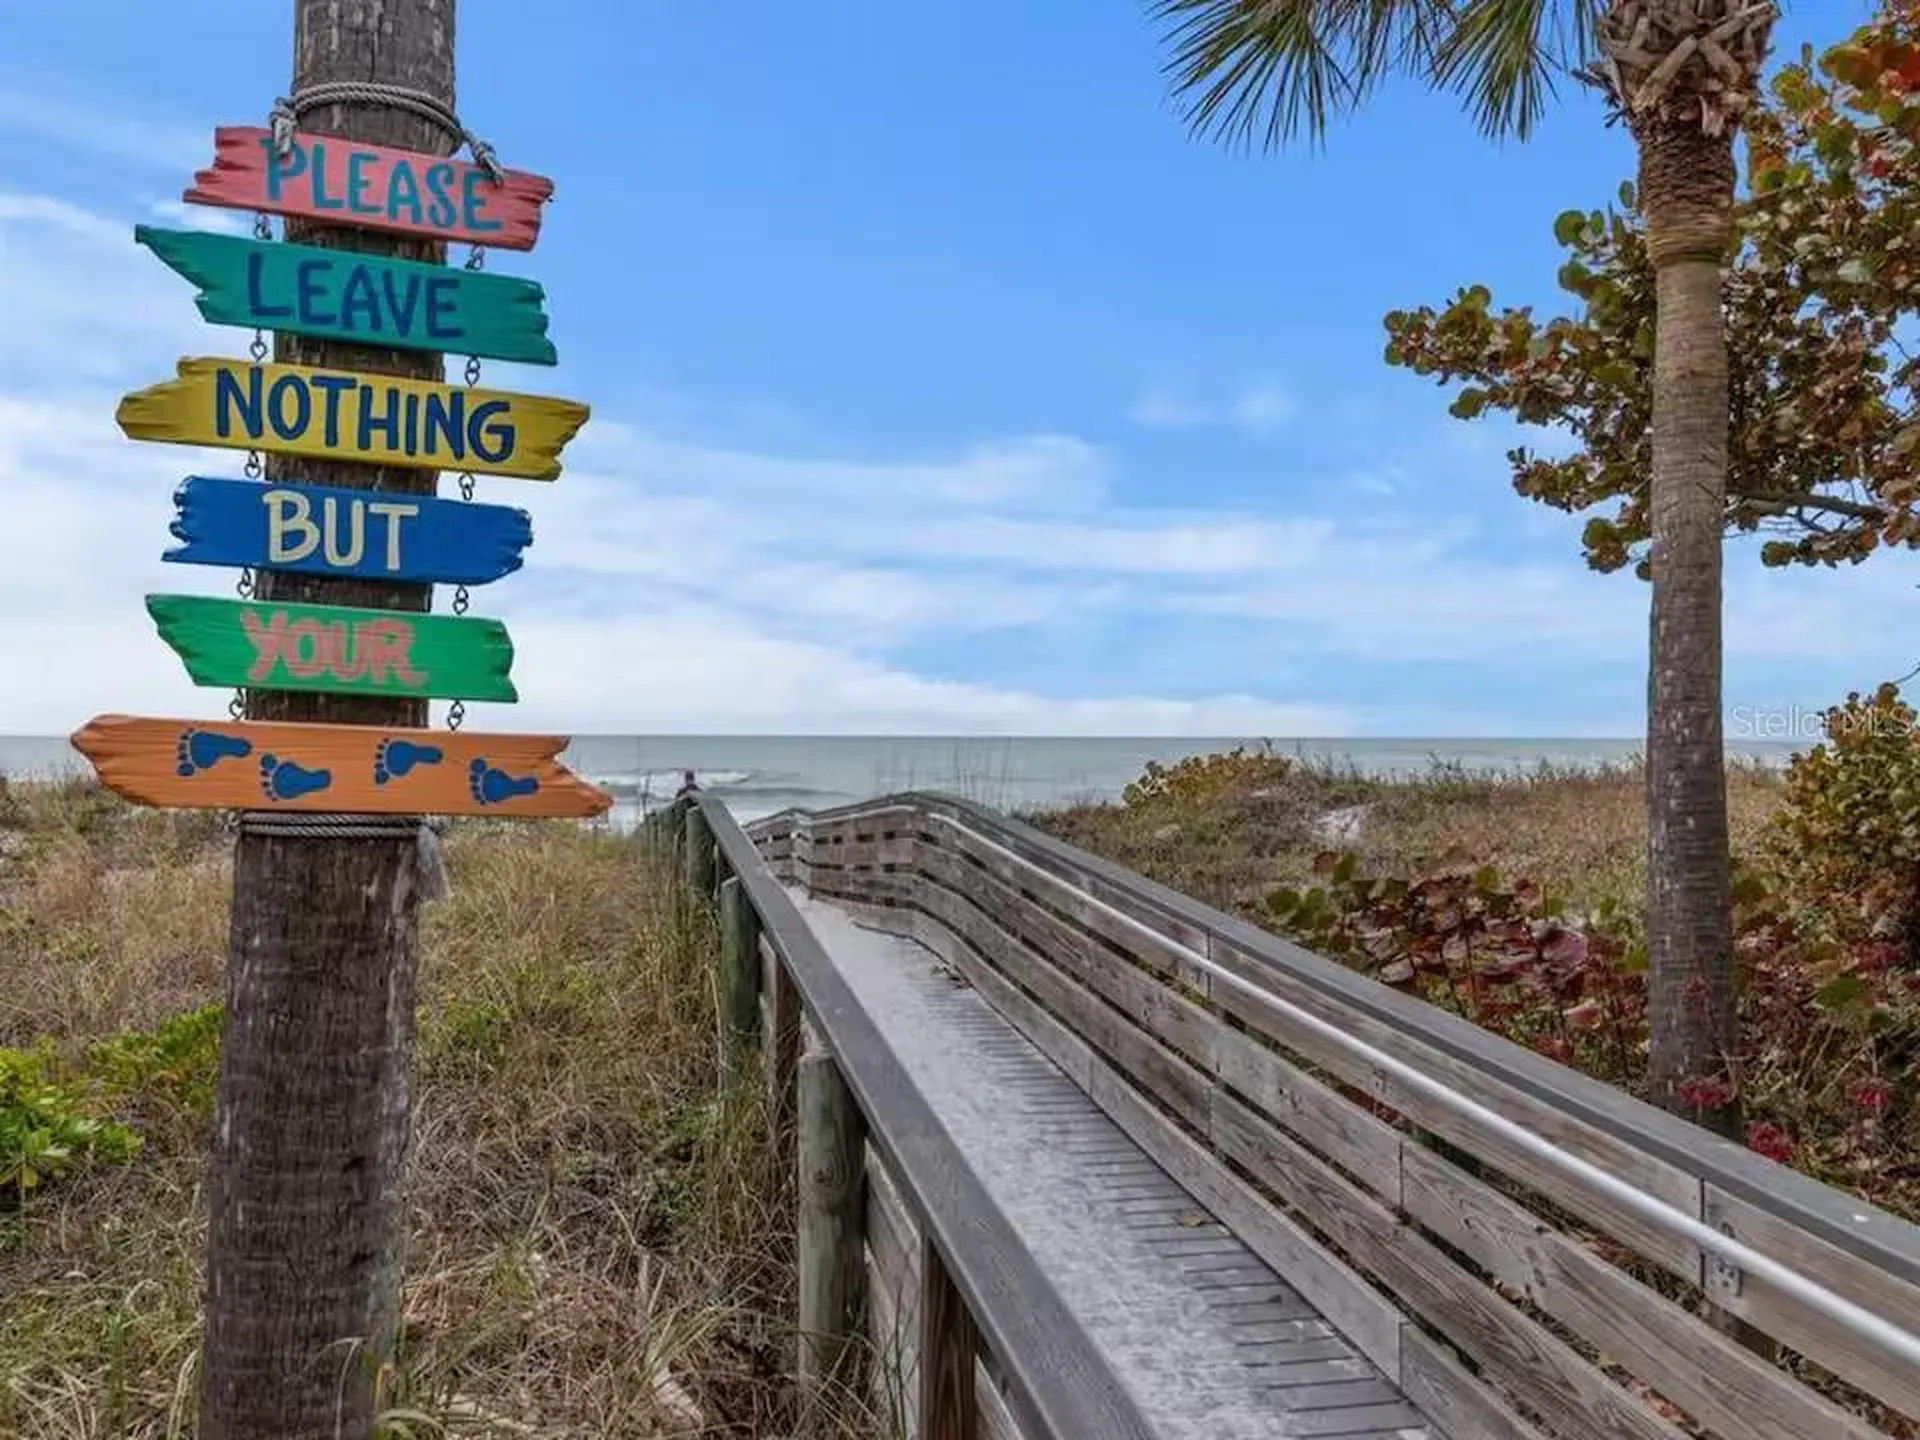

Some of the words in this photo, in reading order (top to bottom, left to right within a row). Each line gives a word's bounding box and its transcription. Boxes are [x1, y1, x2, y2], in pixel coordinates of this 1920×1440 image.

[257, 137, 504, 232] PLEASE
[247, 251, 465, 338] LEAVE
[215, 367, 516, 464] NOTHING
[262, 489, 419, 571] BUT
[241, 610, 429, 688] YOUR
